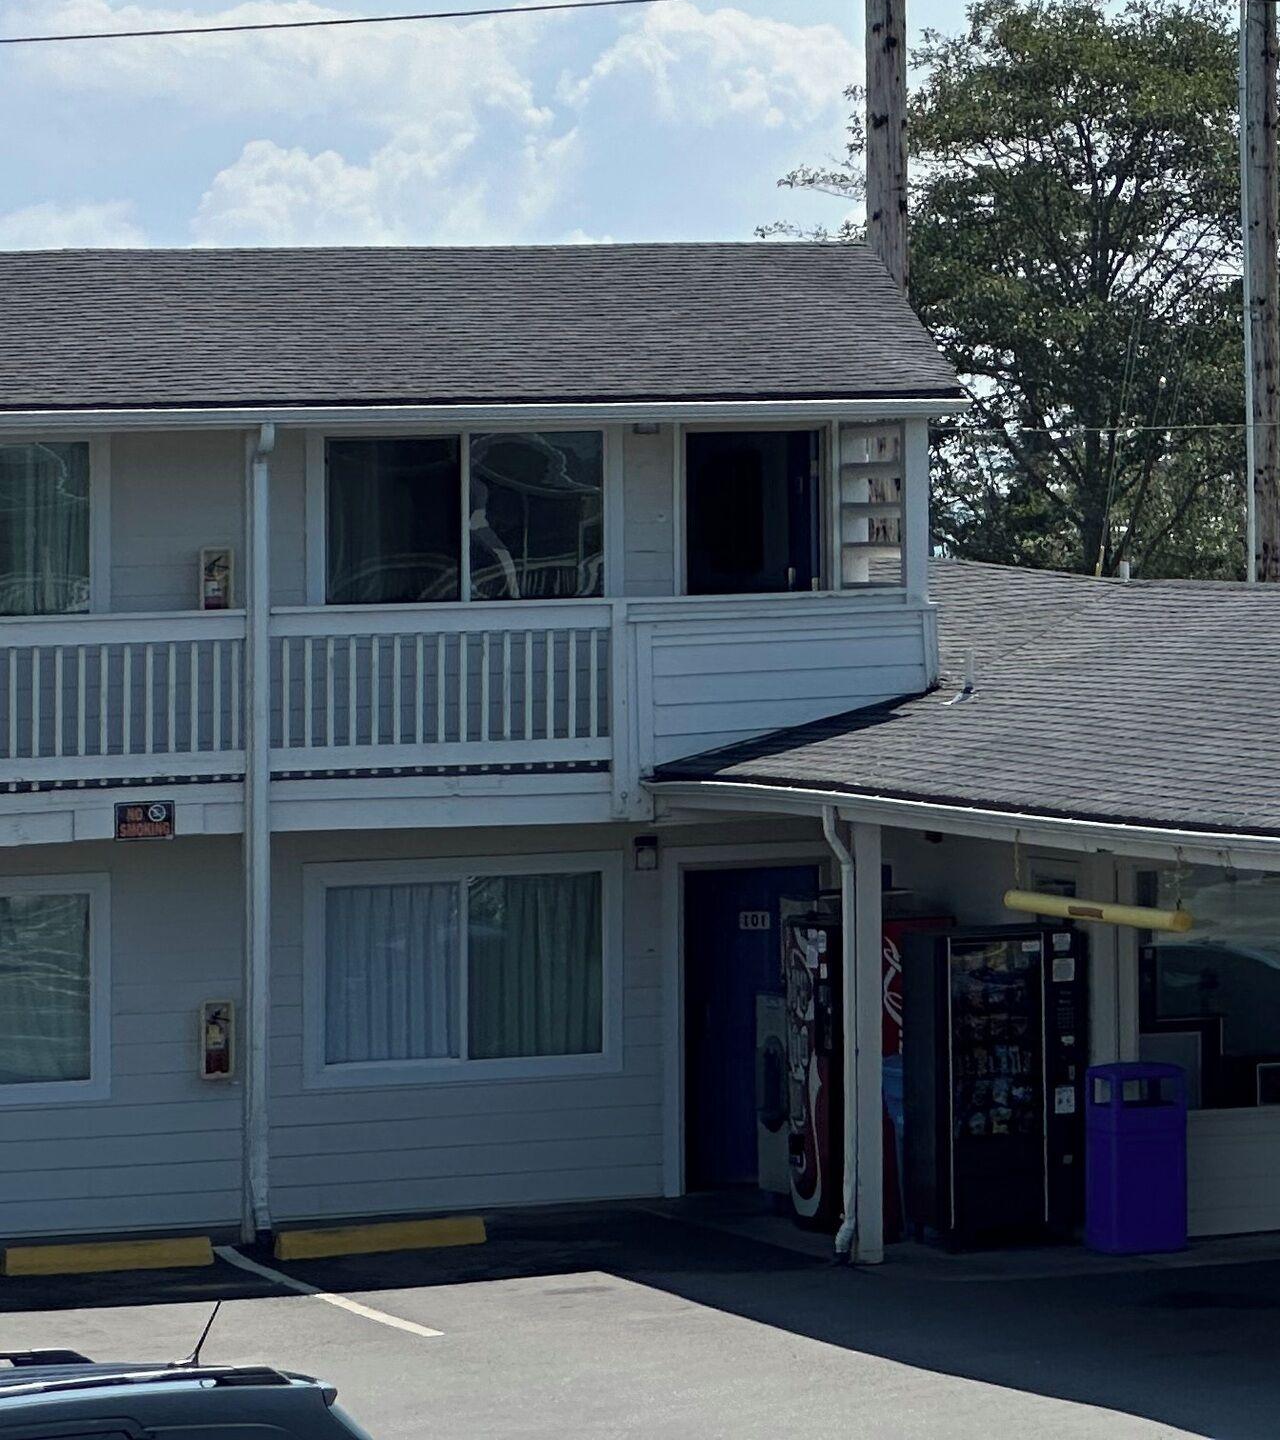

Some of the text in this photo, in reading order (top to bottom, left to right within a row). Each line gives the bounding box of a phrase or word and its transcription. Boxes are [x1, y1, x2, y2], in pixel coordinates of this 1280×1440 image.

[126, 807, 143, 821] NO
[119, 822, 170, 837] SMOKING
[744, 914, 765, 927] 101
